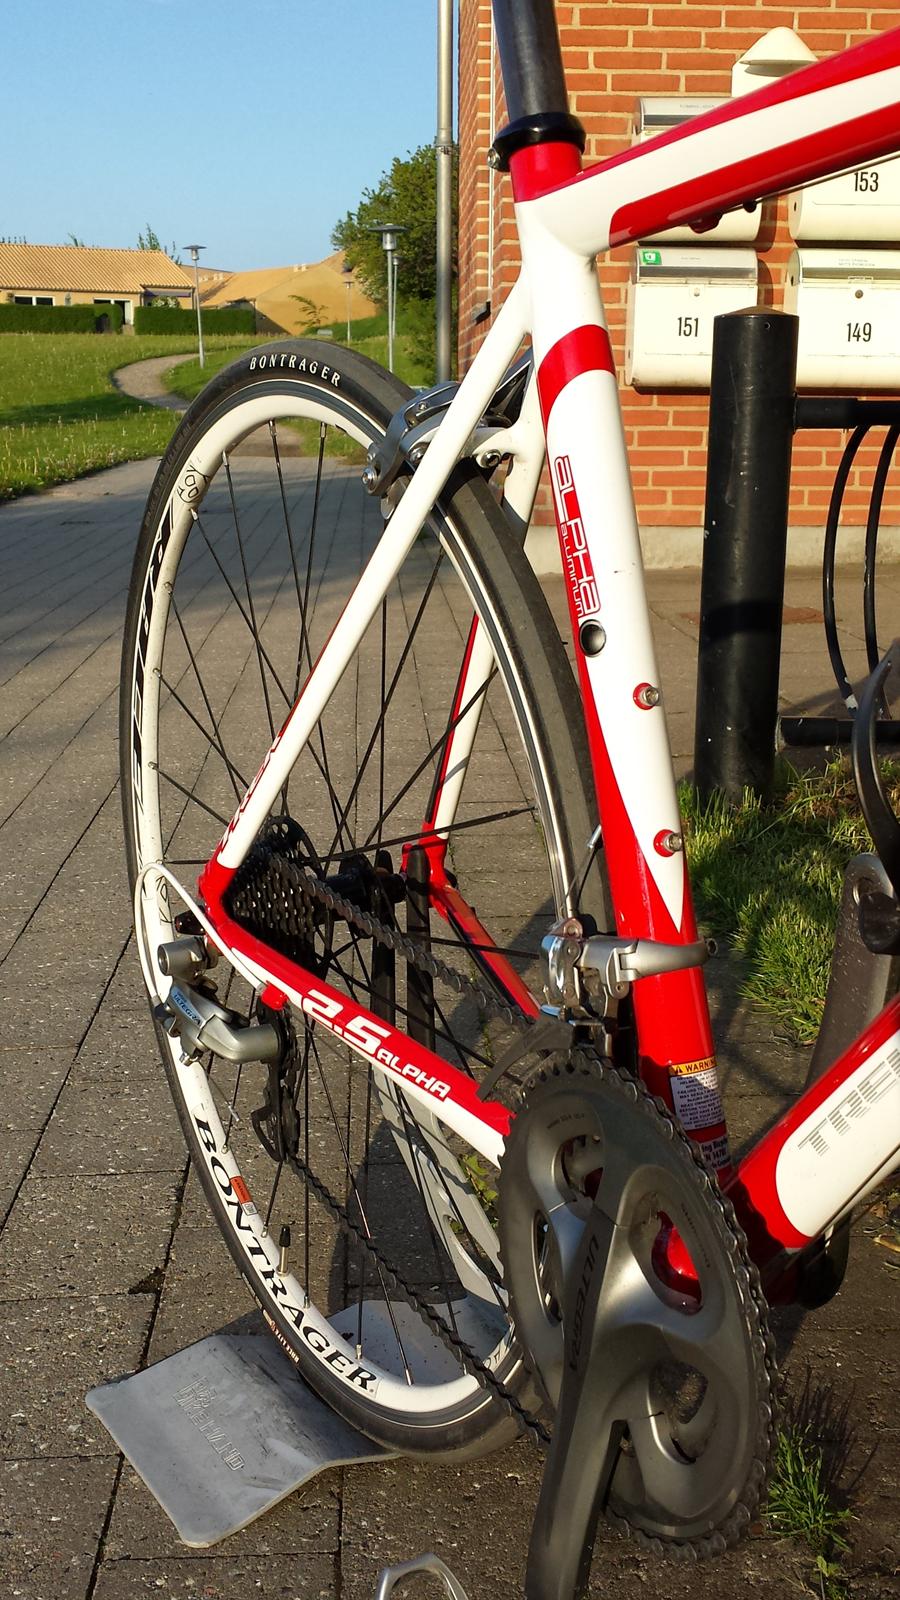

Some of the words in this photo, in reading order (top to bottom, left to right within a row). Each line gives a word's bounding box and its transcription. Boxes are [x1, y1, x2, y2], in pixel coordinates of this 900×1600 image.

[854, 171, 879, 193] 153
[677, 317, 699, 338] 151
[846, 322, 872, 343] 149
[249, 353, 341, 388] BONTRAGER
[173, 994, 202, 1025] ULTEGRA
[302, 989, 392, 1056] 2.5
[376, 1049, 452, 1098] ALPHA
[193, 1115, 377, 1392] BONTRAGER
